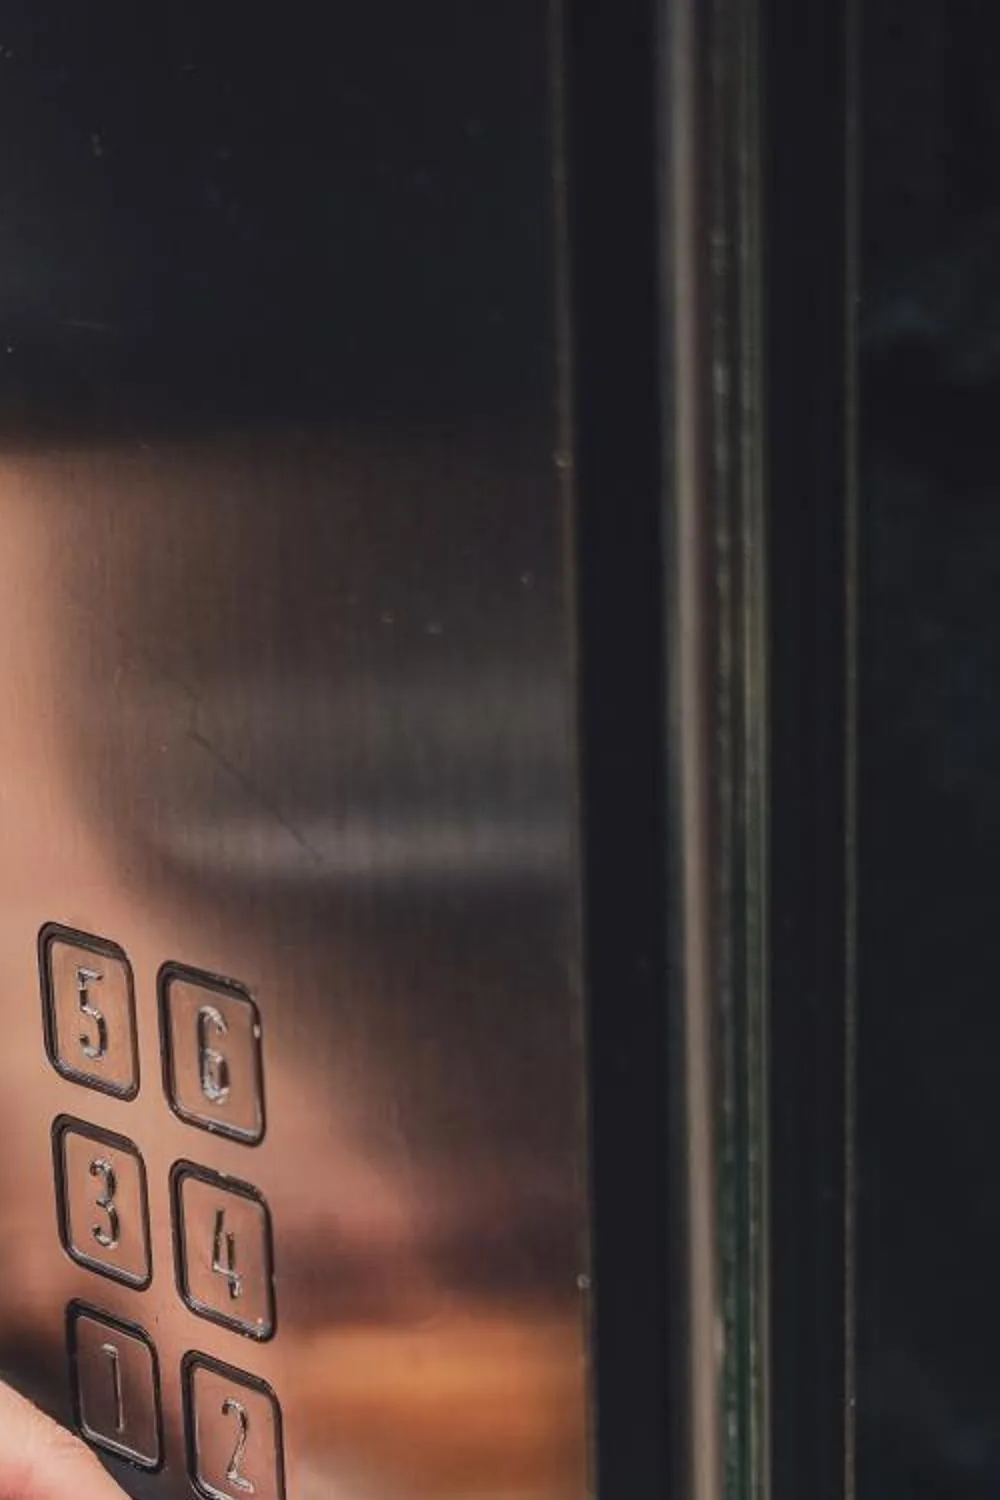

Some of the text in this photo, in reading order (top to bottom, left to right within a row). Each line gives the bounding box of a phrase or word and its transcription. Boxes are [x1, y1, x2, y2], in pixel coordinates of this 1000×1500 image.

[77, 966, 108, 1060] 5
[200, 1005, 230, 1106] 6
[89, 1158, 118, 1248] 3
[211, 1208, 241, 1301] 4
[101, 1343, 125, 1432] 1
[222, 1398, 252, 1492] 2
